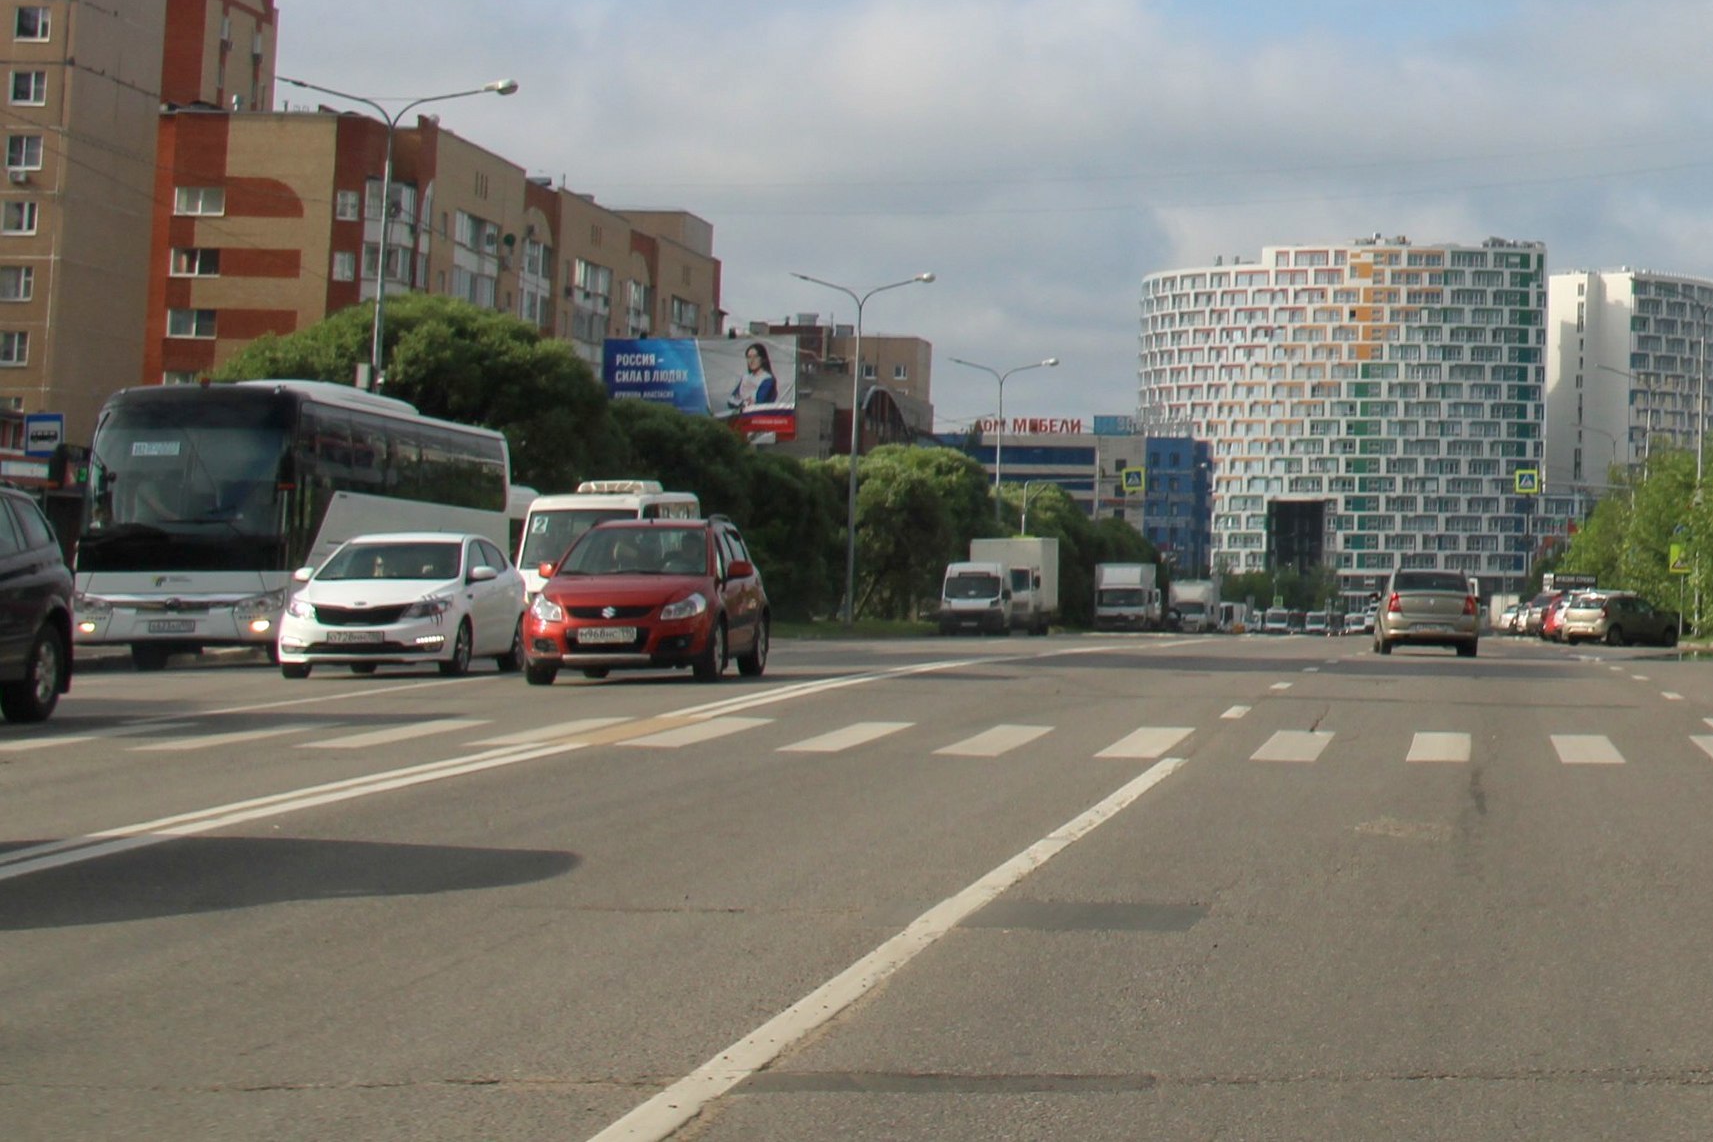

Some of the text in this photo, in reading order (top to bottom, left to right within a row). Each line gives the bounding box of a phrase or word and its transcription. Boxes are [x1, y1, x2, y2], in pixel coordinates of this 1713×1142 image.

[615, 353, 656, 367] РОССИЯ
[615, 369, 689, 384] СИЛА В ЛЮДЯХ
